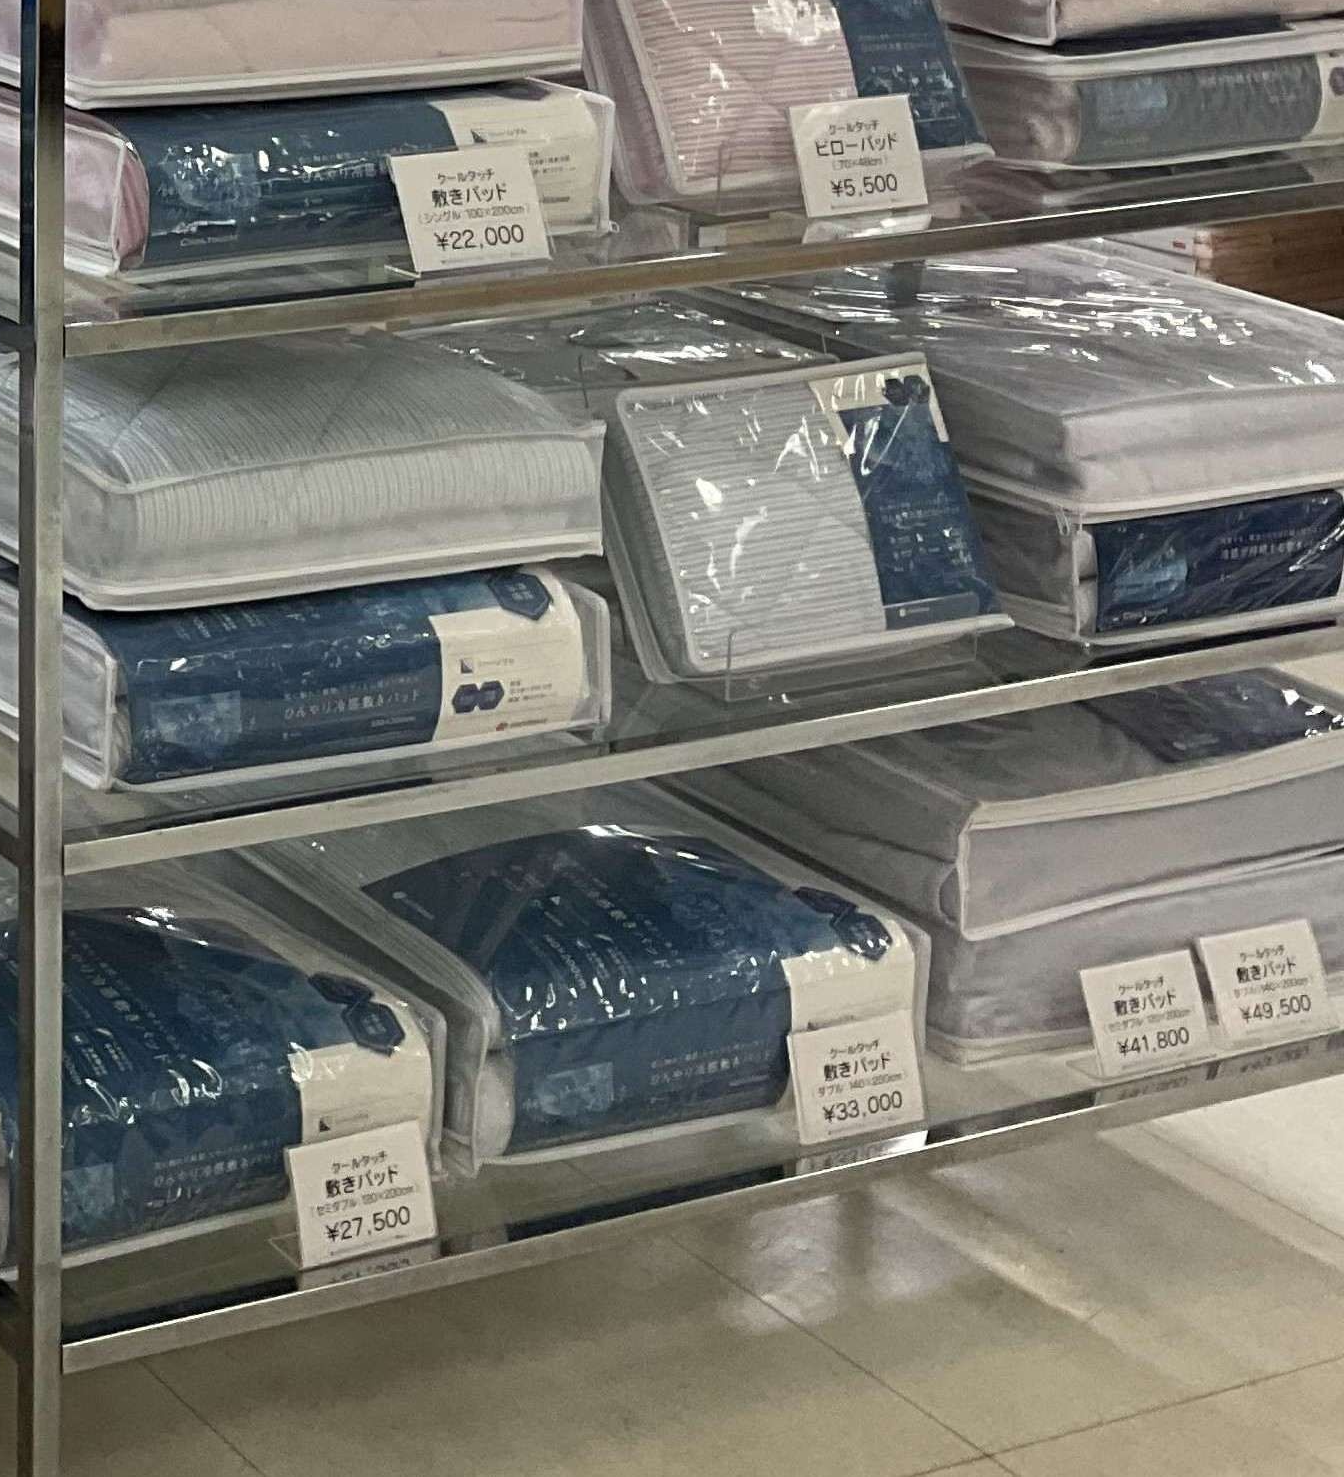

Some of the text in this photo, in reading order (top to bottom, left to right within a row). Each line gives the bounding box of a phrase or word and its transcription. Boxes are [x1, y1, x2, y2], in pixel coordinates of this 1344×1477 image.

[815, 132, 897, 157] ピローパッド
[437, 168, 496, 185] クールタッチ
[830, 173, 898, 197] ¥5,500
[431, 182, 507, 208] 敷きパッド
[433, 224, 524, 252] ¥22,000
[1236, 956, 1297, 985] 敷きパッド
[1113, 988, 1177, 1018] 敷きパッド
[1239, 993, 1312, 1024] ¥49,500
[1117, 1026, 1190, 1058] ¥41,800
[823, 1051, 891, 1082] 敷きパッド
[822, 1090, 903, 1123] ¥33,000
[331, 1150, 388, 1175] クールタッチ
[325, 1164, 399, 1198] 敷きパッド
[324, 1205, 411, 1242] ¥27,500
